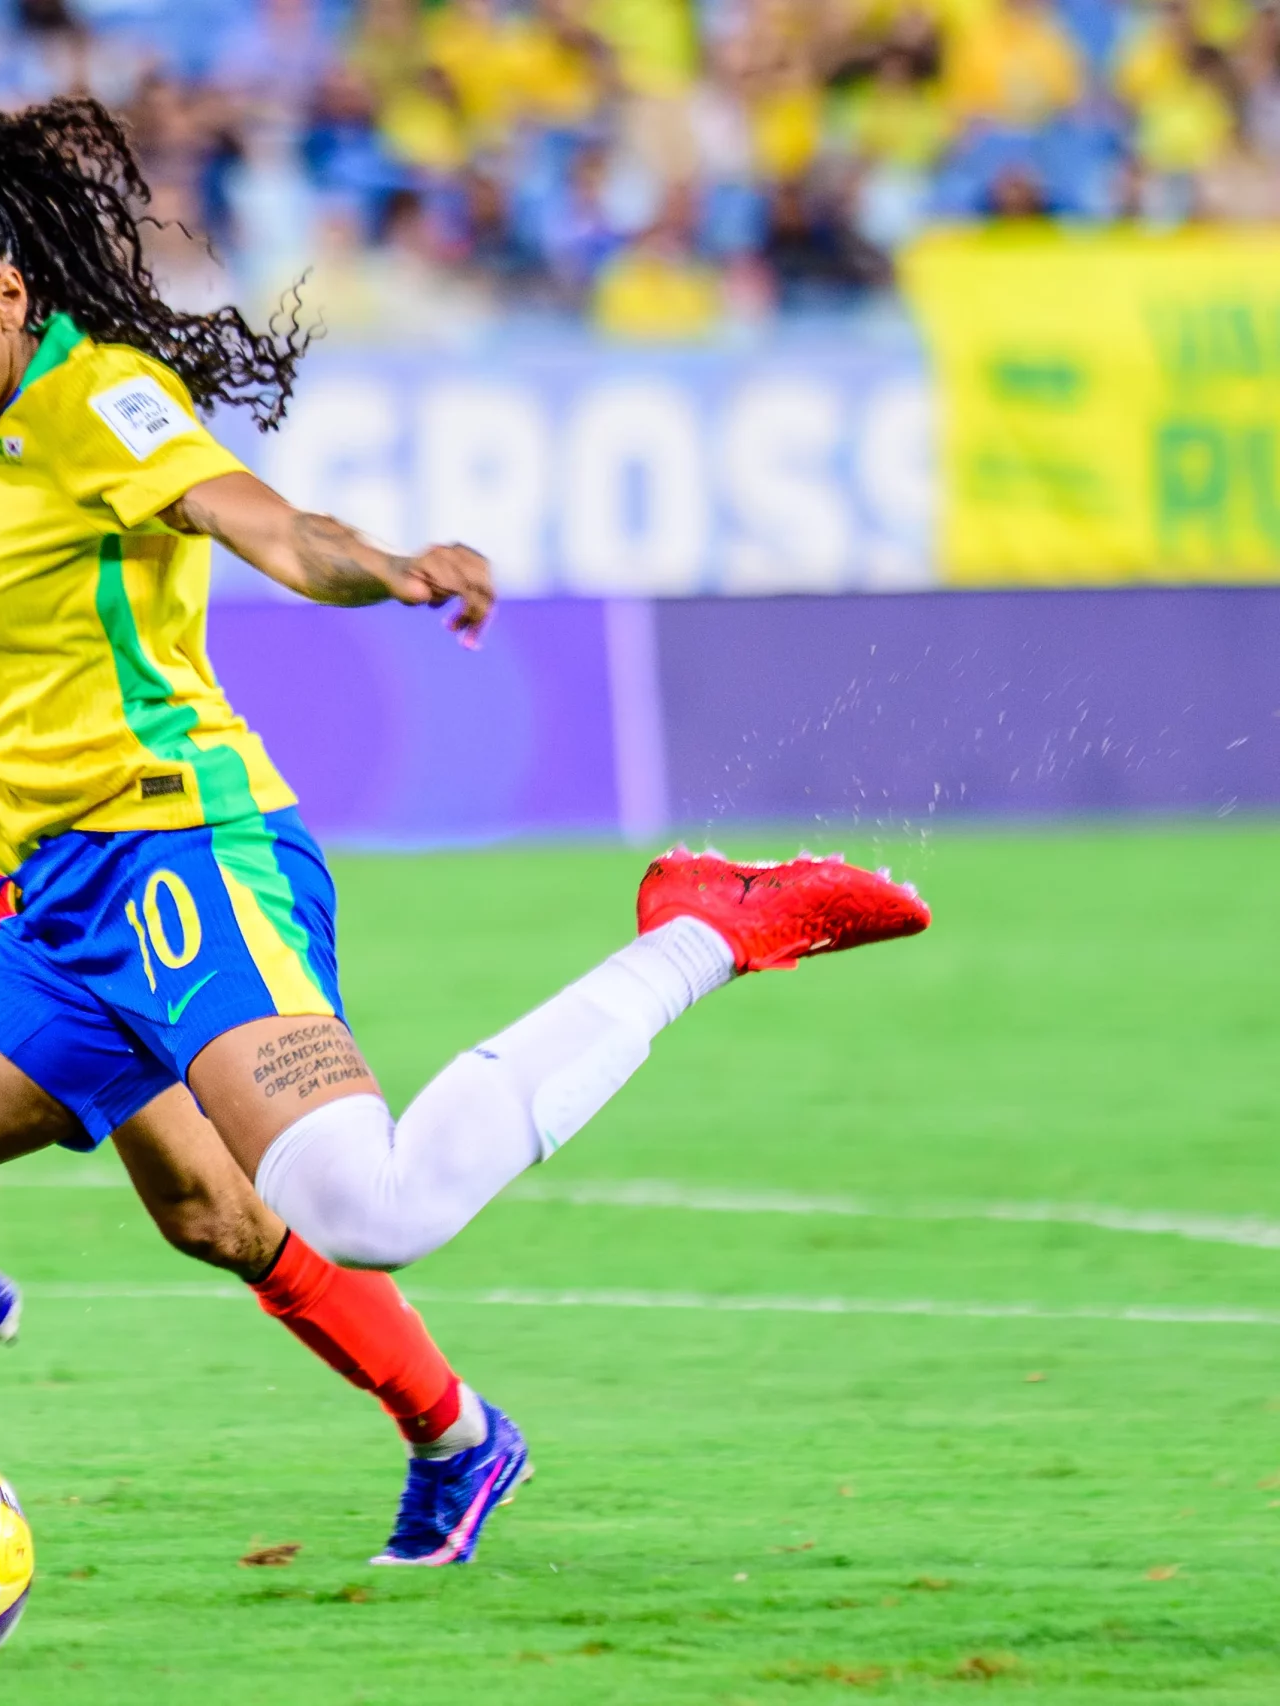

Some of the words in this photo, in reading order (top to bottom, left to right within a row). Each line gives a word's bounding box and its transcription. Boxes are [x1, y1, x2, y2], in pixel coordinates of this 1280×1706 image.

[124, 868, 202, 995] 10
[257, 1042, 276, 1060] AS
[298, 1078, 321, 1099] EM
